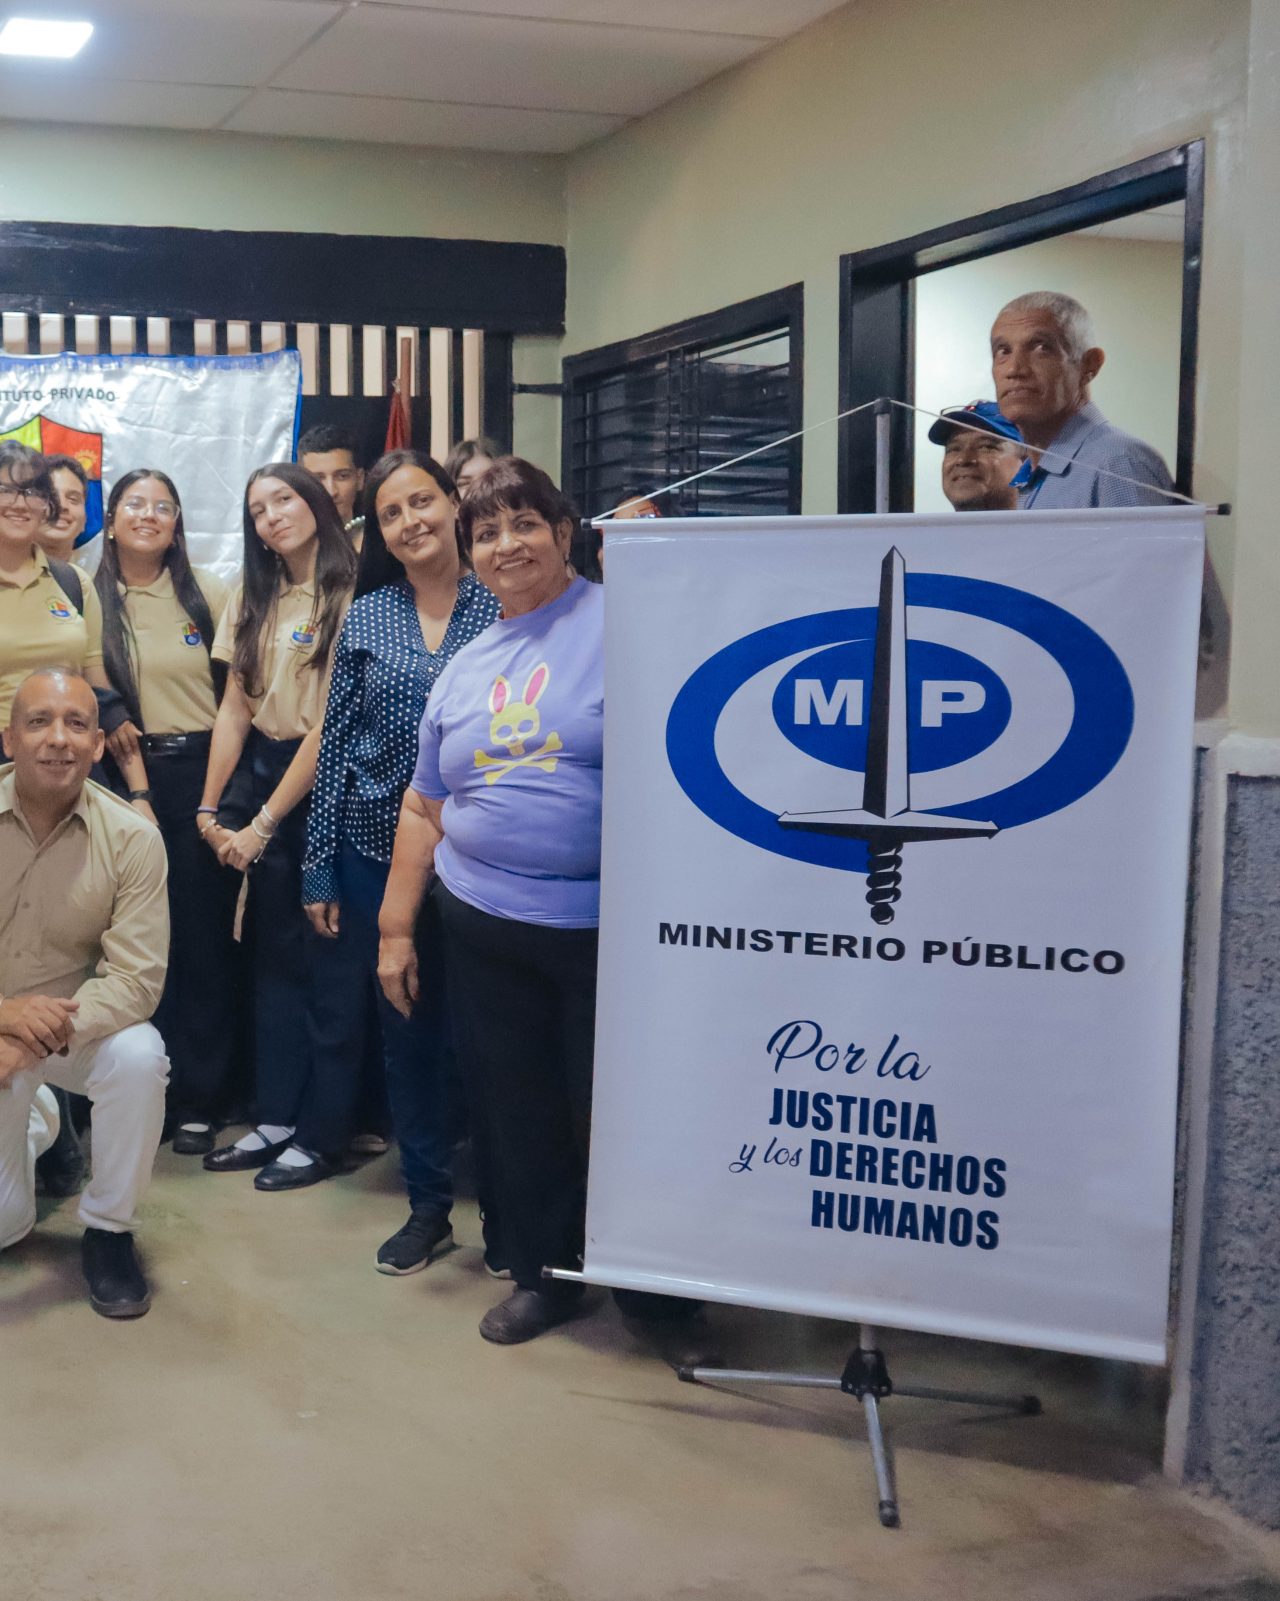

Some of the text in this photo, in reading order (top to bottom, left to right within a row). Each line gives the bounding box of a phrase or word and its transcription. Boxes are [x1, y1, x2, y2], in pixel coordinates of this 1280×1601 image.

[51, 387, 116, 402] PRIVADO
[658, 922, 1126, 975] MINISTERIO PÚBLICO
[766, 1020, 931, 1081] Por la
[768, 1087, 938, 1144] JUSTICIA
[728, 1136, 1007, 1198] y los DERECHOS
[811, 1189, 1000, 1250] HUMANOS
